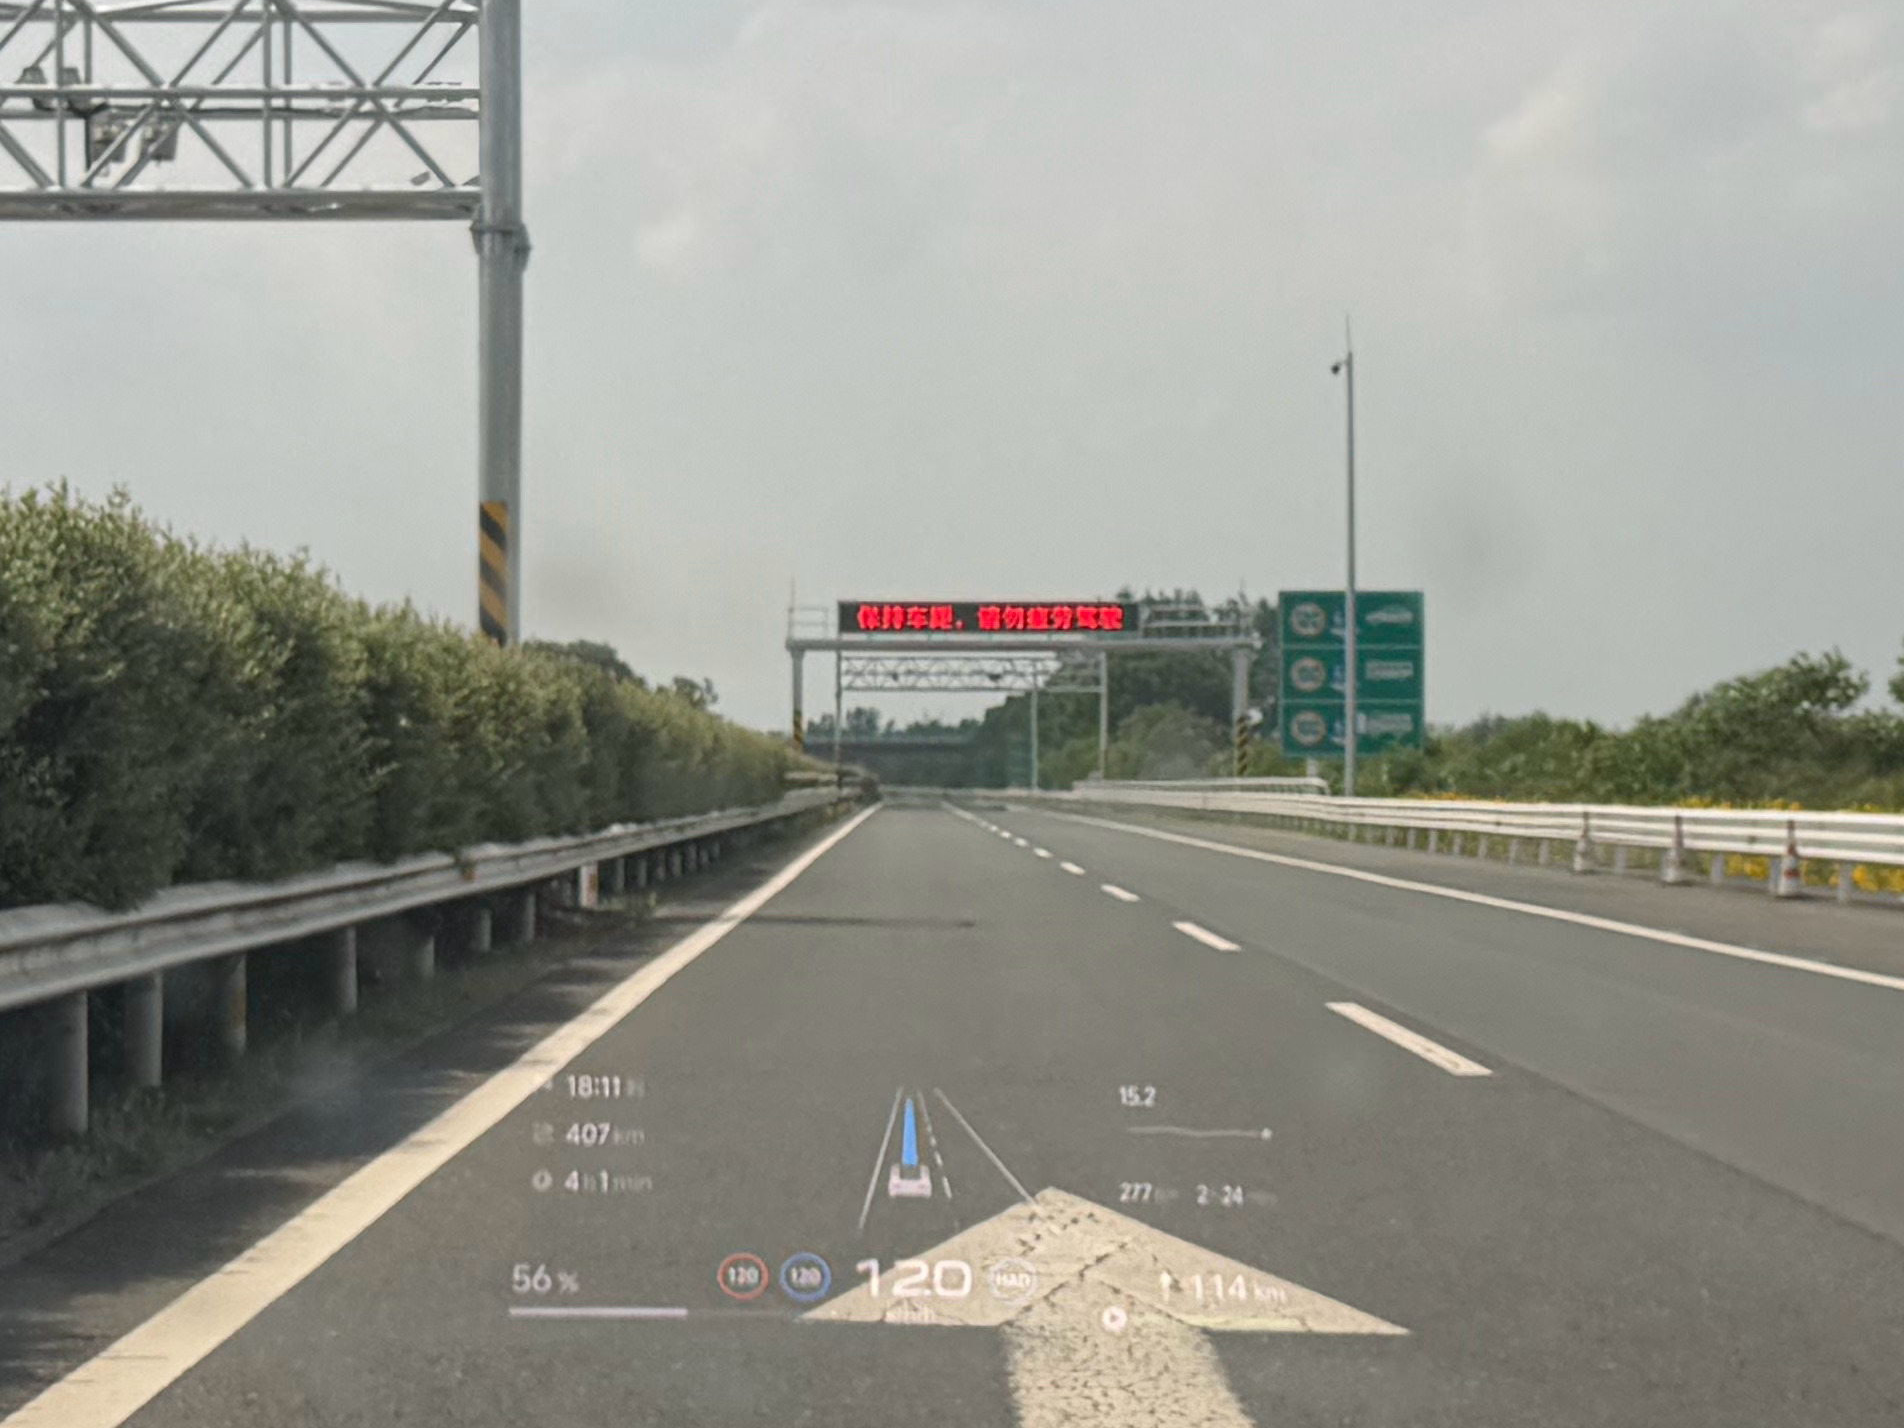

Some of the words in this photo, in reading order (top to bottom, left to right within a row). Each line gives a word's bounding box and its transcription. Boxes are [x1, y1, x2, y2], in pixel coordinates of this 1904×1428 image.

[566, 1074, 621, 1098] 18:11
[1118, 1085, 1156, 1107] 15.2
[565, 1122, 610, 1146] 407
[564, 1169, 579, 1193] 4
[512, 1263, 553, 1294] 56
[557, 1270, 580, 1294] %
